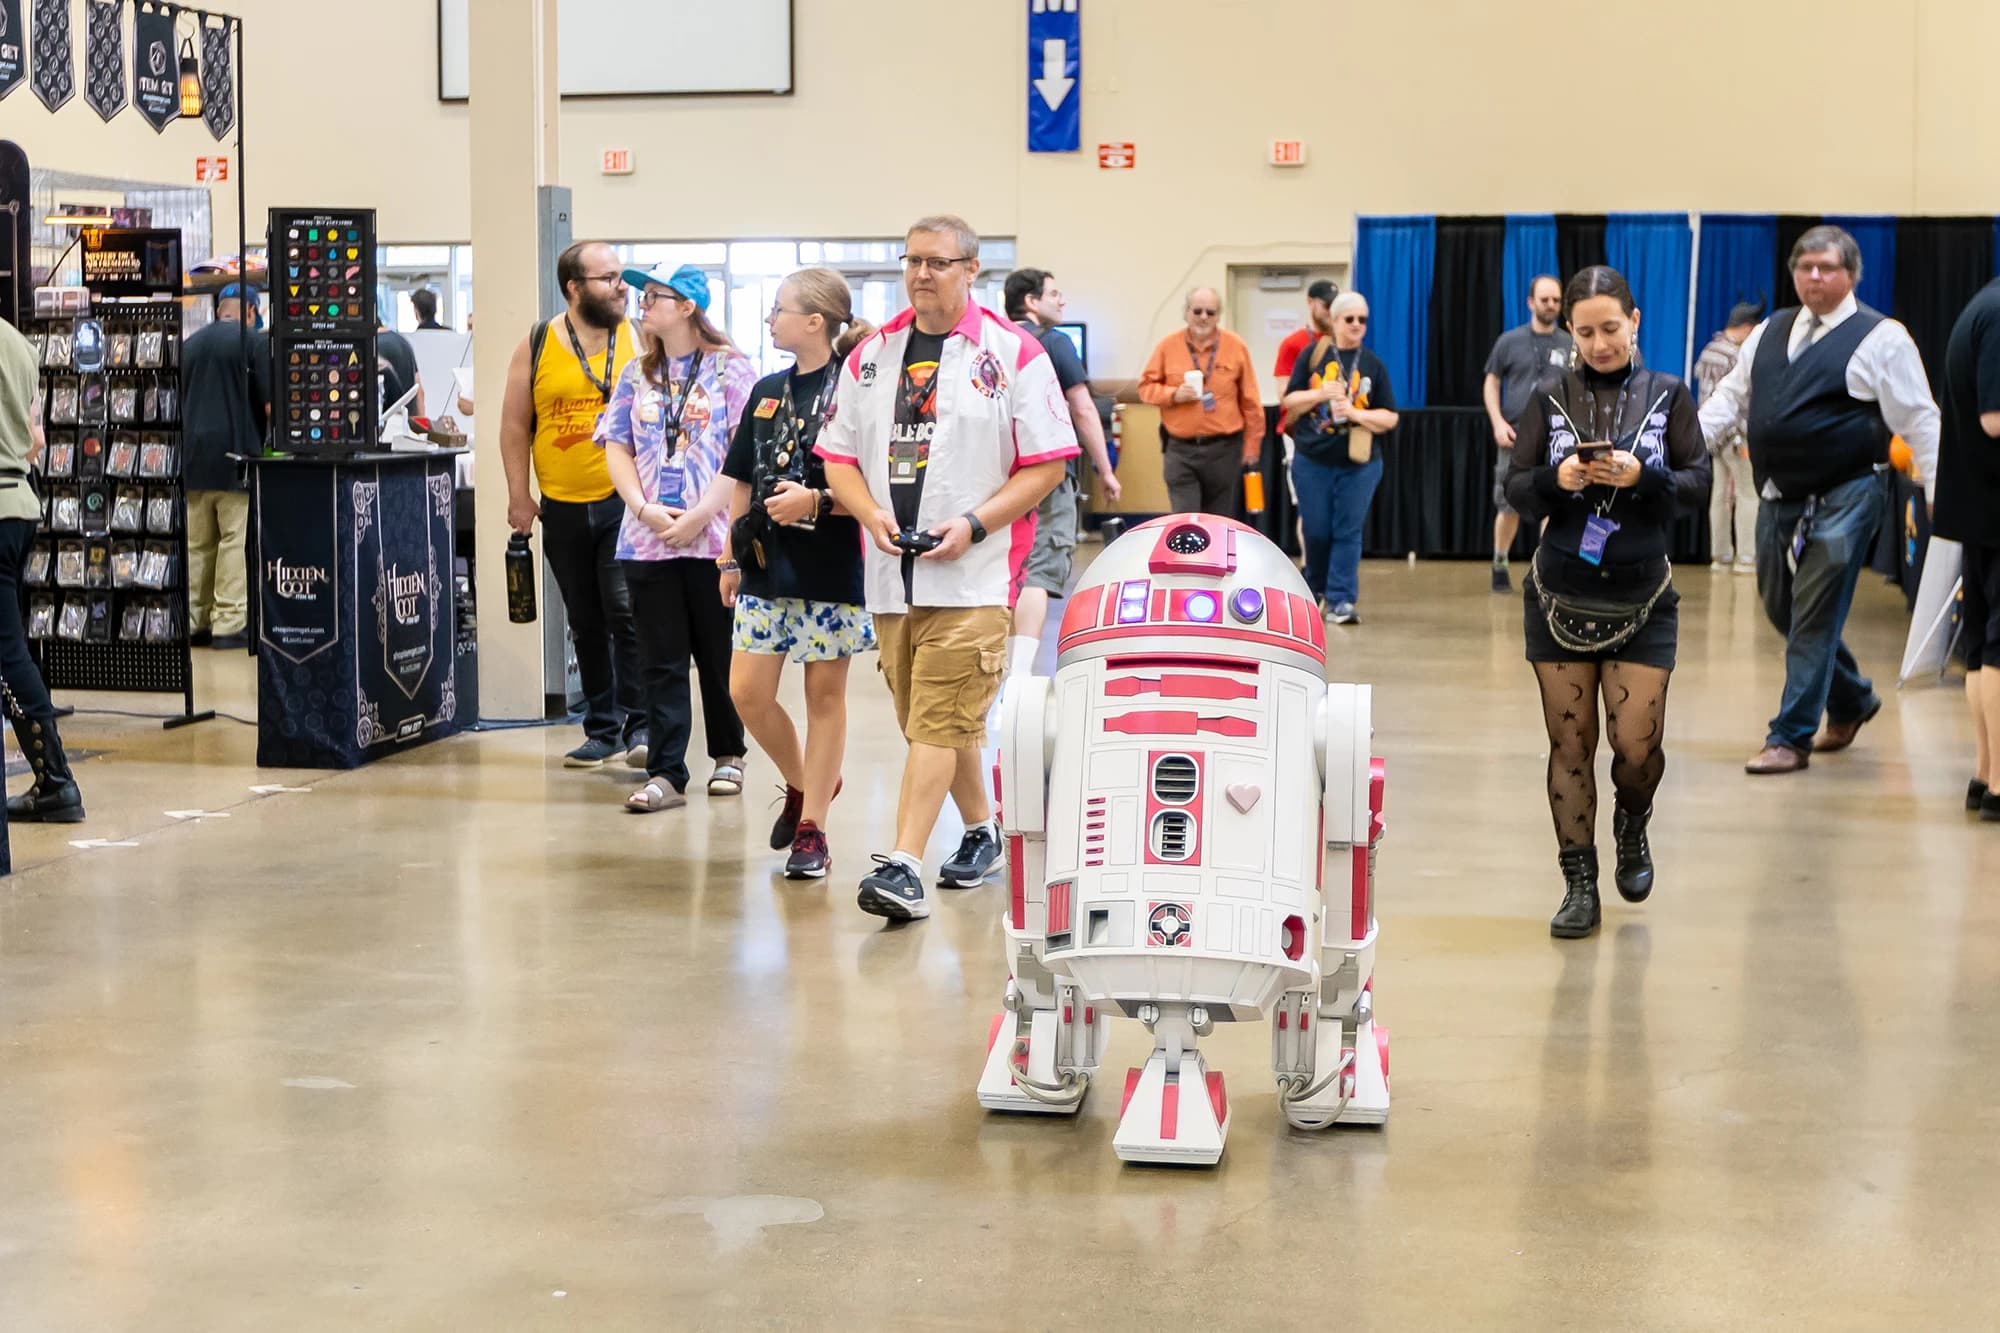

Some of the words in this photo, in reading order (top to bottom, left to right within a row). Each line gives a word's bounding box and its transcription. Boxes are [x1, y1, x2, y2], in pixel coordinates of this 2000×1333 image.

[604, 151, 628, 169] EXIT
[1275, 142, 1300, 161] EXIT
[267, 557, 330, 584] HIDDEN
[387, 563, 427, 601] HIDDEN
